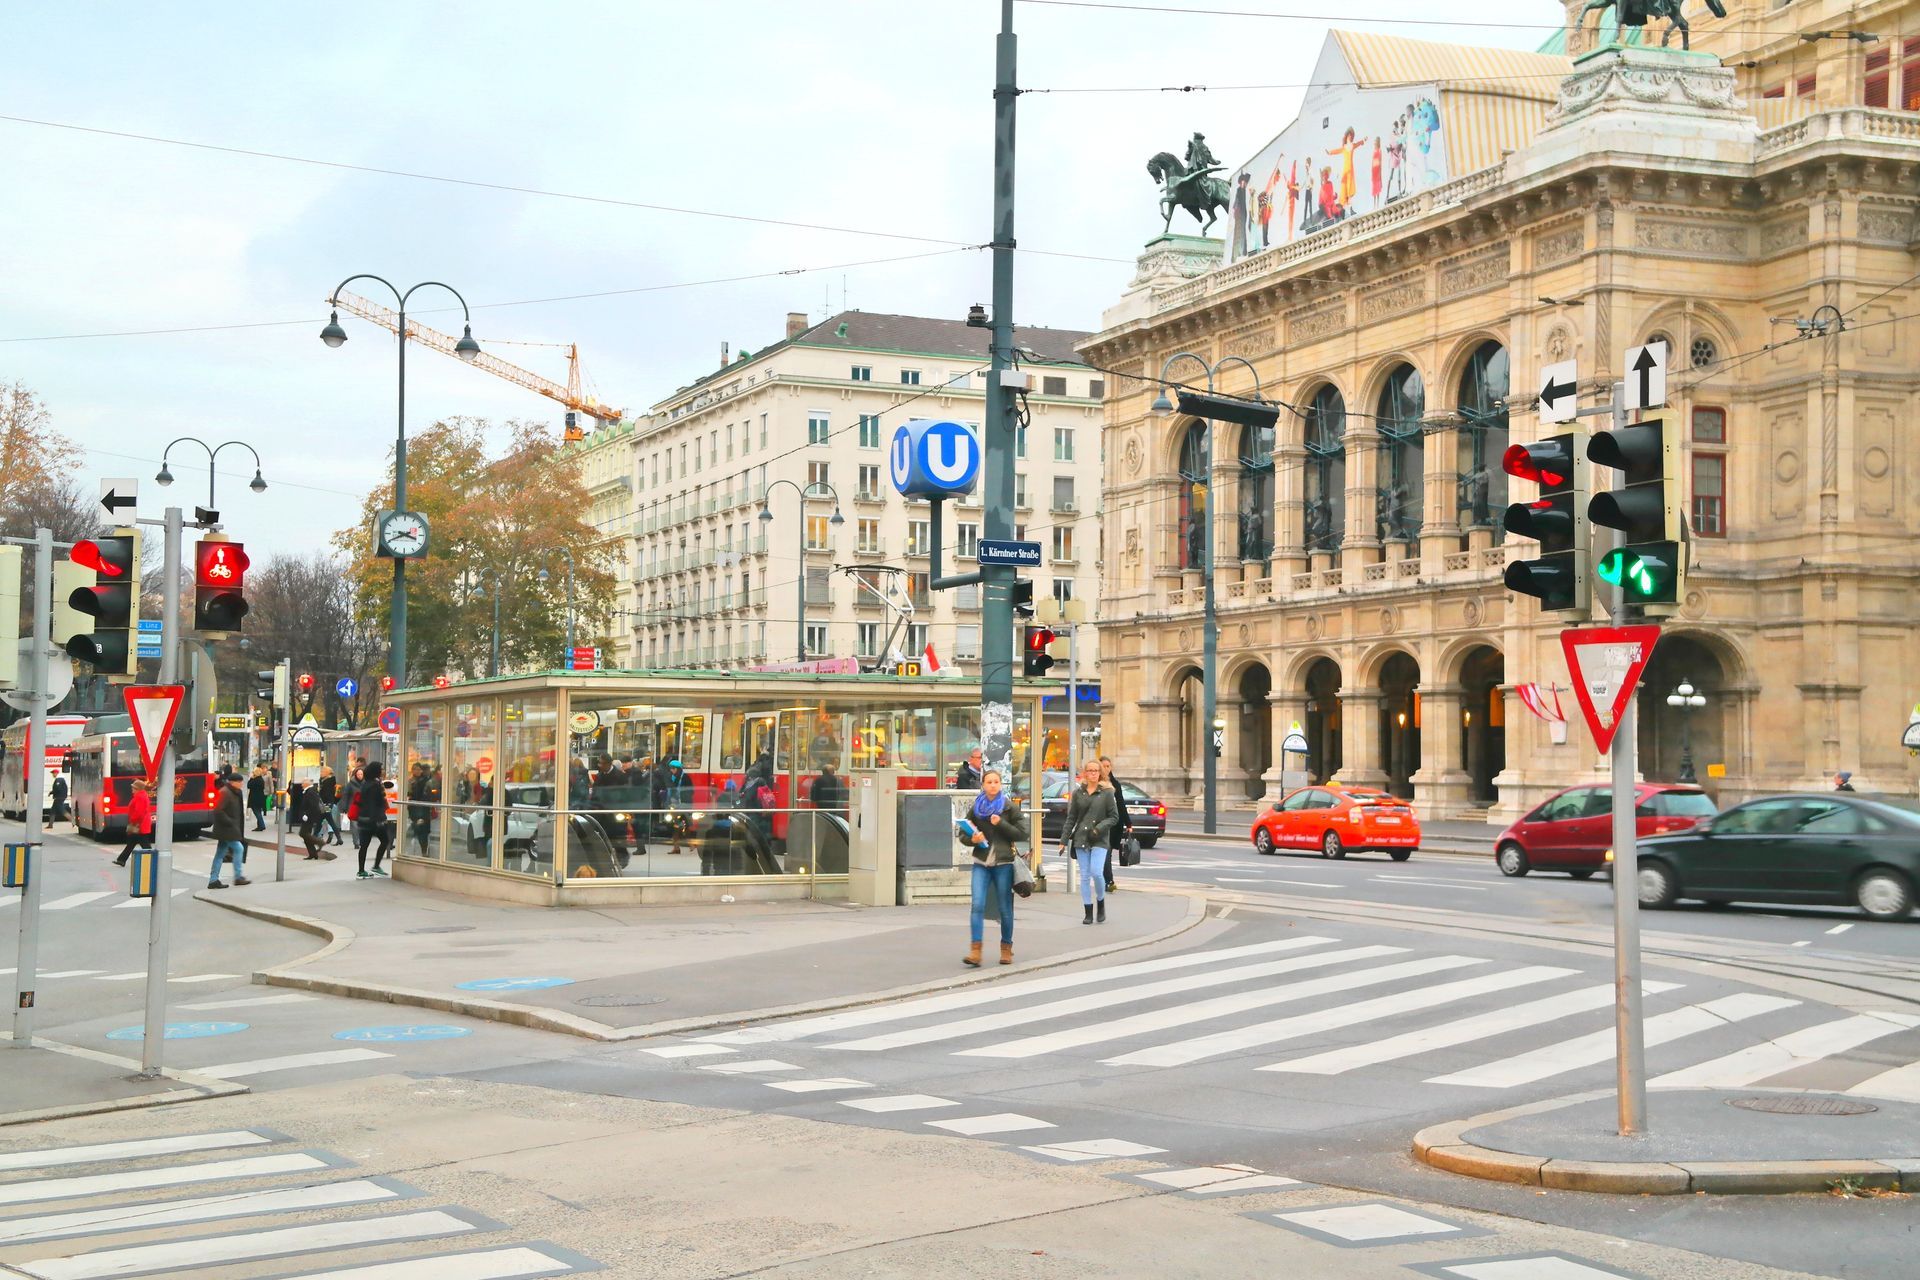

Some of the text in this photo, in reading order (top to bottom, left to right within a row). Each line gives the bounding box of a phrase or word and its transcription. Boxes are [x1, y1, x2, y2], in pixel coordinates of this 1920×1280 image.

[893, 435, 909, 485] U
[927, 433, 969, 482] U
[989, 546, 1018, 558] Kärntner
[1019, 549, 1040, 559] Straße
